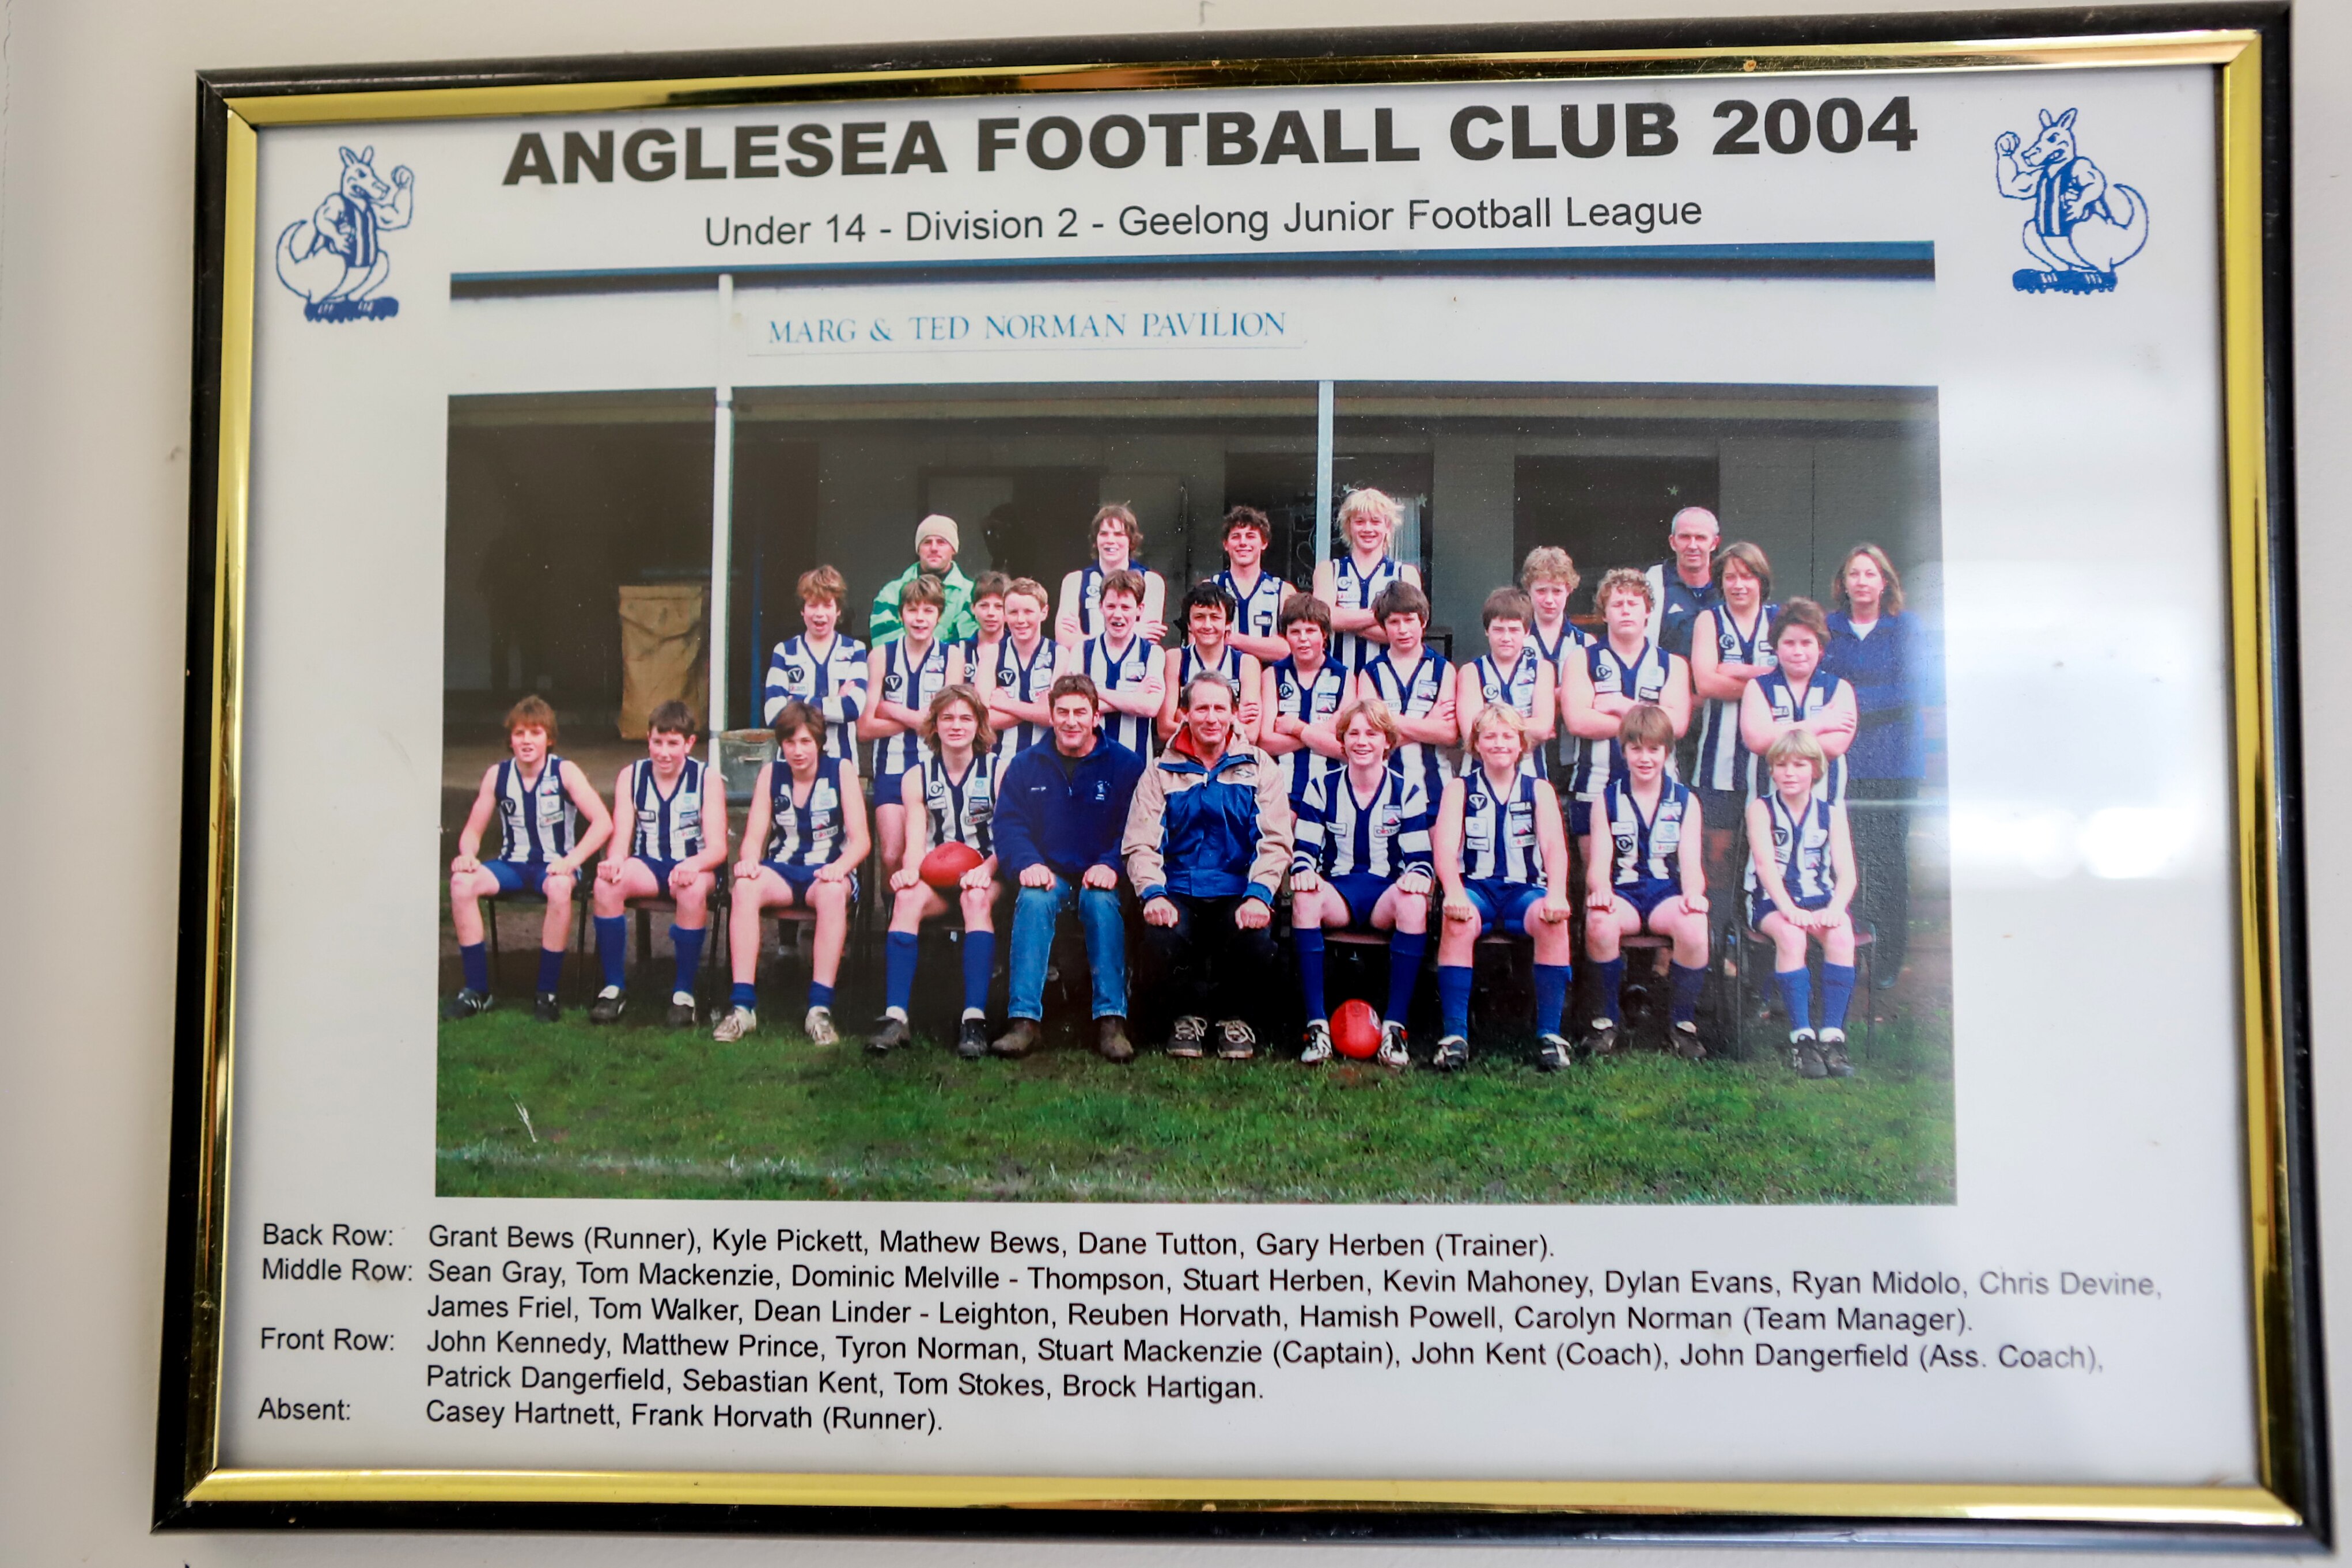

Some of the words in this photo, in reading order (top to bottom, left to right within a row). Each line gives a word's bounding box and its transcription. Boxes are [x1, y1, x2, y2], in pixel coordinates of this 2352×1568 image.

[503, 120, 948, 185] ANGLESEA
[978, 108, 1420, 172] FOOTBALL
[1450, 102, 1679, 161] CLUB
[1713, 96, 1918, 155] 2004
[706, 215, 811, 247] Under
[827, 214, 866, 243] 14
[907, 209, 1043, 241] Division
[1058, 207, 1078, 237] 2
[1119, 204, 1268, 241] Geelong
[1283, 201, 1394, 233] Junior
[1409, 197, 1550, 230] Football
[1567, 196, 1702, 234] League
[769, 317, 856, 344] MARG
[869, 317, 893, 342] &
[908, 316, 969, 341] TED
[986, 313, 1124, 339] NORMAN
[1143, 311, 1285, 338] PAVILION
[263, 1222, 324, 1246] Back
[332, 1223, 393, 1247] Row:
[428, 1224, 498, 1248] Grant
[507, 1225, 575, 1249] Bews
[584, 1226, 702, 1256] (Runner),
[713, 1227, 767, 1257] Kyle
[777, 1228, 869, 1256] Pickett,
[880, 1229, 981, 1254] Mathew
[990, 1230, 1067, 1259] Bews,
[1078, 1230, 1147, 1256] Dane
[1155, 1231, 1245, 1260] Tutton,
[1256, 1231, 1320, 1263] Gary
[1329, 1232, 1425, 1257] Herben
[1435, 1233, 1554, 1263] (Trainer).
[262, 1257, 342, 1282] Middle
[351, 1258, 413, 1283] Row:
[427, 1259, 491, 1283] Sean
[502, 1259, 566, 1290] Gray,
[575, 1260, 629, 1285] Tom
[639, 1262, 781, 1291] Mackenzie,
[791, 1263, 895, 1289] Dominic
[904, 1264, 1000, 1290] Melville
[1027, 1266, 1172, 1296] Thompson,
[1183, 1267, 1260, 1292] Stuart
[1269, 1267, 1372, 1297] Herben,
[1384, 1268, 1456, 1293] Kevin
[1467, 1268, 1594, 1300] Mahoney,
[1605, 1269, 1680, 1300] Dylan
[1691, 1270, 1781, 1298] Evans,
[1792, 1270, 1861, 1301] Ryan
[1872, 1270, 1968, 1299] Midolo,
[1979, 1270, 2050, 1296] Chris
[2060, 1271, 2161, 1299] Devine,
[426, 1294, 509, 1319] James
[518, 1295, 579, 1323] Friel,
[588, 1296, 642, 1320] Tom
[650, 1297, 743, 1325] Walker,
[754, 1298, 821, 1323] Dean
[832, 1299, 912, 1324] Linder
[939, 1301, 1056, 1331] Leighton,
[1068, 1302, 1169, 1327] Reuben
[1180, 1303, 1288, 1332] Horvath,
[1300, 1304, 1399, 1329] Hamish
[1410, 1304, 1503, 1333] Powell,
[1514, 1304, 1616, 1336] Carolyn
[1627, 1305, 1732, 1331] Norman
[1743, 1306, 1826, 1336] (Team
[1837, 1306, 1972, 1338] Manager).
[260, 1326, 325, 1351] Front
[334, 1327, 395, 1351] Row:
[426, 1329, 486, 1353] John
[497, 1330, 611, 1361] Kennedy,
[622, 1332, 730, 1357] Matthew
[738, 1333, 825, 1362] Prince,
[835, 1335, 907, 1365] Tyron
[918, 1336, 1027, 1365] Norman,
[1037, 1336, 1114, 1362] Stuart
[1123, 1338, 1263, 1364] Mackenzie
[1272, 1339, 1400, 1370] (Captain),
[1411, 1340, 1475, 1365] John
[1486, 1341, 1547, 1366] Kent
[1556, 1340, 1669, 1372] (Coach),
[1679, 1342, 1744, 1367] John
[1755, 1342, 1908, 1373] Dangerfield
[1919, 1343, 1987, 1373] (Ass.
[1997, 1343, 2103, 1374] Coach),
[427, 1364, 512, 1388] Patrick
[521, 1365, 672, 1396] Dangerfield,
[682, 1368, 808, 1393] Sebastian
[819, 1370, 884, 1399] Kent,
[893, 1371, 948, 1396] Tom
[957, 1371, 1051, 1401] Stokes,
[1063, 1373, 1137, 1398] Brock
[1147, 1374, 1264, 1405] Hartigan.
[257, 1396, 351, 1422] Absent:
[426, 1399, 506, 1430] Casey
[514, 1400, 620, 1430] Hartnett,
[632, 1402, 704, 1427] Frank
[714, 1404, 812, 1429] Horvath
[823, 1406, 942, 1437] (Runner).
